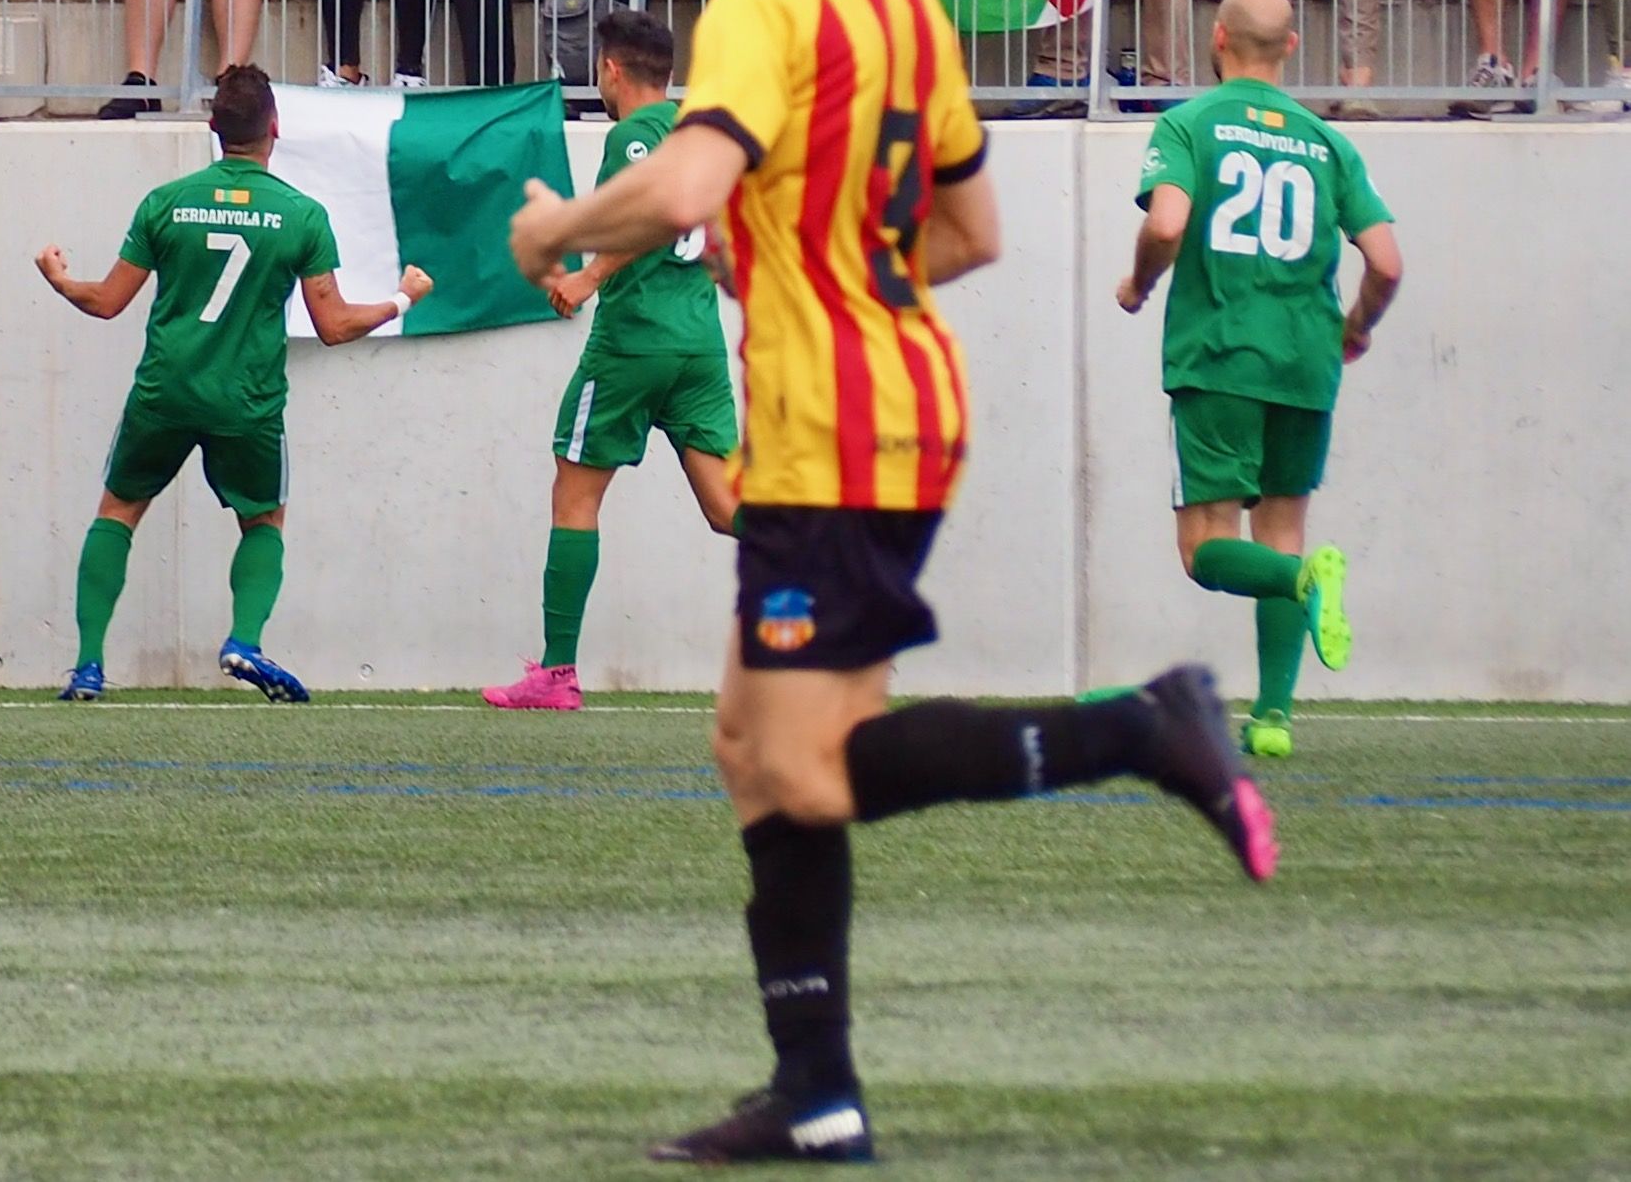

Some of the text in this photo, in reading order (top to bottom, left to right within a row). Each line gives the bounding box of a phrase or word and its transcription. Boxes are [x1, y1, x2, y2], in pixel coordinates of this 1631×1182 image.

[1213, 124, 1330, 163] CERDANYOLA FC
[172, 207, 283, 229] CERDANYOLA FC
[1210, 149, 1315, 261] 20
[198, 231, 252, 323] 7
